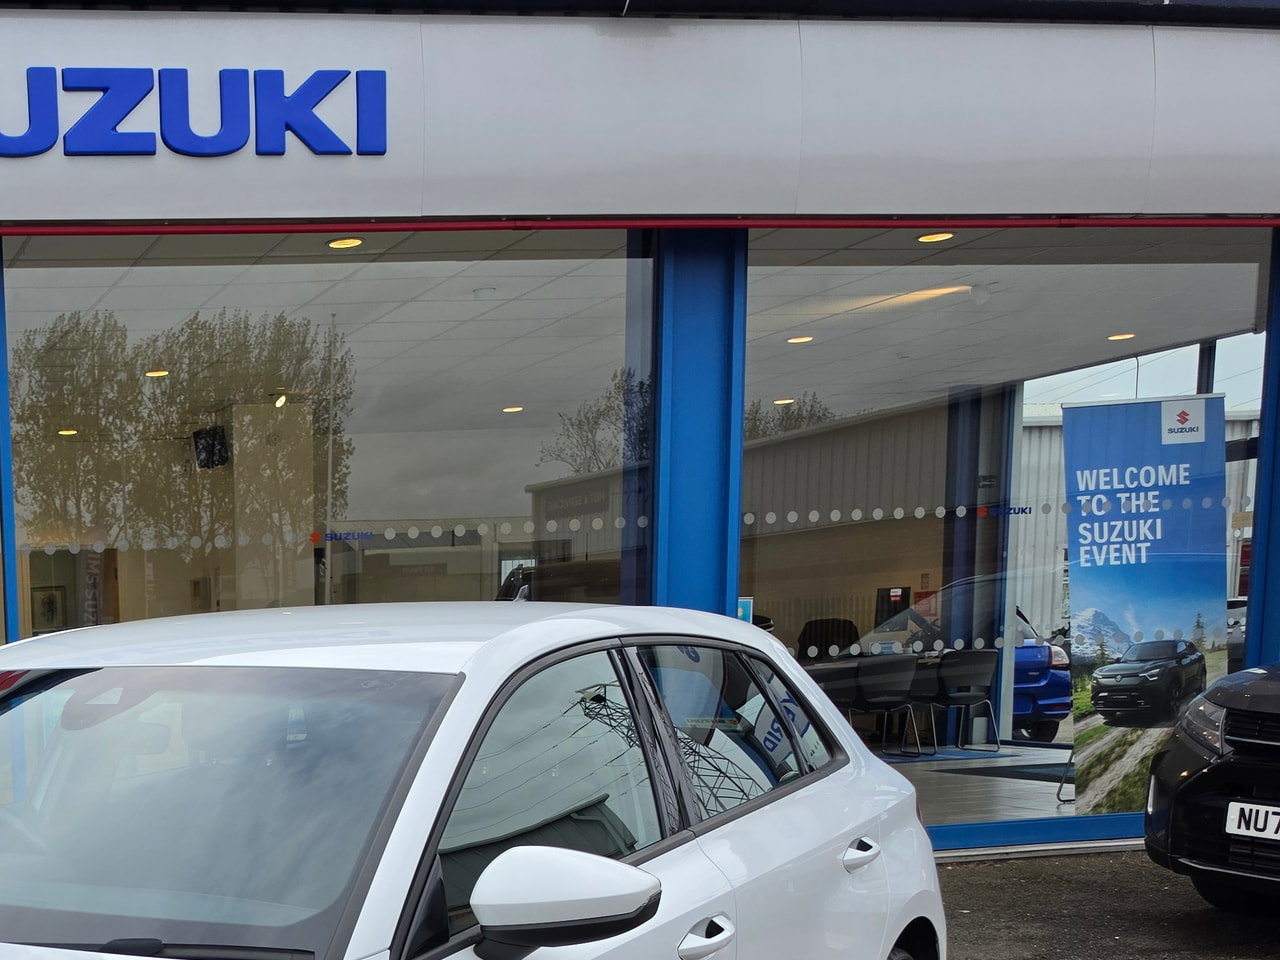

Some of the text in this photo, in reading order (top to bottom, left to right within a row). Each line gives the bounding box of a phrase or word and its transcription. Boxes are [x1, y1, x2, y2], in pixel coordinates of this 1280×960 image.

[1167, 426, 1199, 434] SUZUKI
[1076, 464, 1190, 491] WELCOME
[1077, 491, 1159, 516] TO THE
[1078, 518, 1162, 544] SUZUKI
[1080, 542, 1151, 567] EVENT
[1237, 807, 1280, 835] NU7
